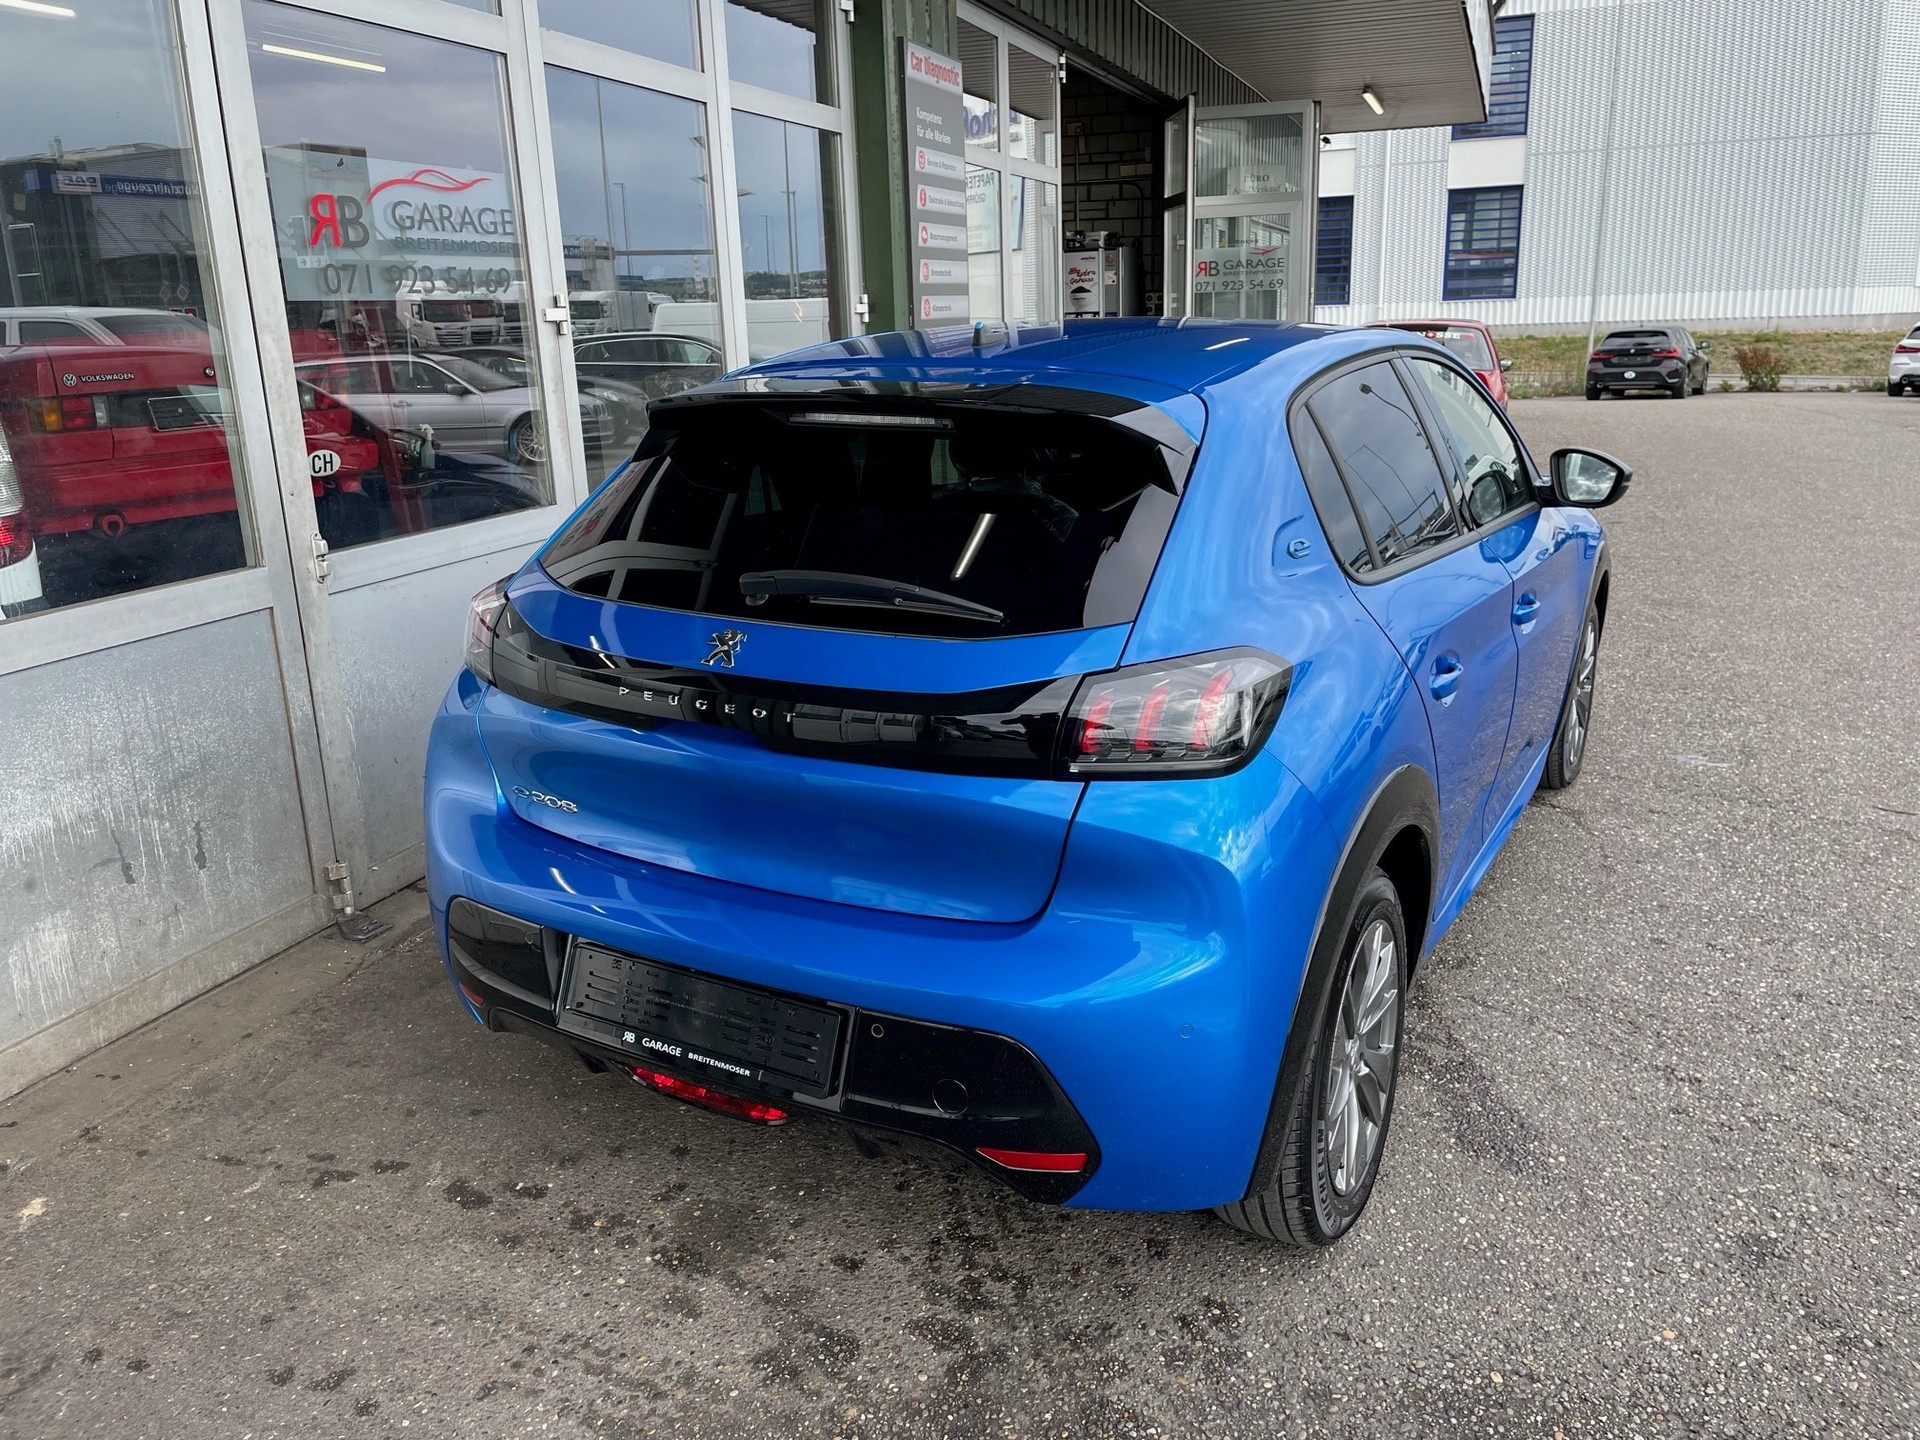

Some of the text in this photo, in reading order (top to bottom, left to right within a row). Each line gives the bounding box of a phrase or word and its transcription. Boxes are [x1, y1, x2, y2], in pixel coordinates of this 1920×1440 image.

[911, 51, 960, 87] Car Diagnostic
[916, 106, 943, 126] Kompetenz
[916, 124, 925, 138] für
[925, 127, 934, 140] alle
[934, 129, 952, 145] Marken
[391, 200, 516, 236] GARAGE
[395, 237, 515, 254] BREITENMOSER
[1223, 257, 1285, 271] GARAGE
[323, 263, 511, 294] 071 923 54 69
[1195, 278, 1284, 292] 071 923 54 69
[80, 372, 135, 383] VOLKSWAGEN
[312, 453, 333, 475] CH
[618, 686, 796, 723] PEUGEOT
[641, 1036, 682, 1057] GARAGE
[687, 1051, 751, 1078] BREITENMOSER
[1317, 1128, 1338, 1227] MICHELIN
